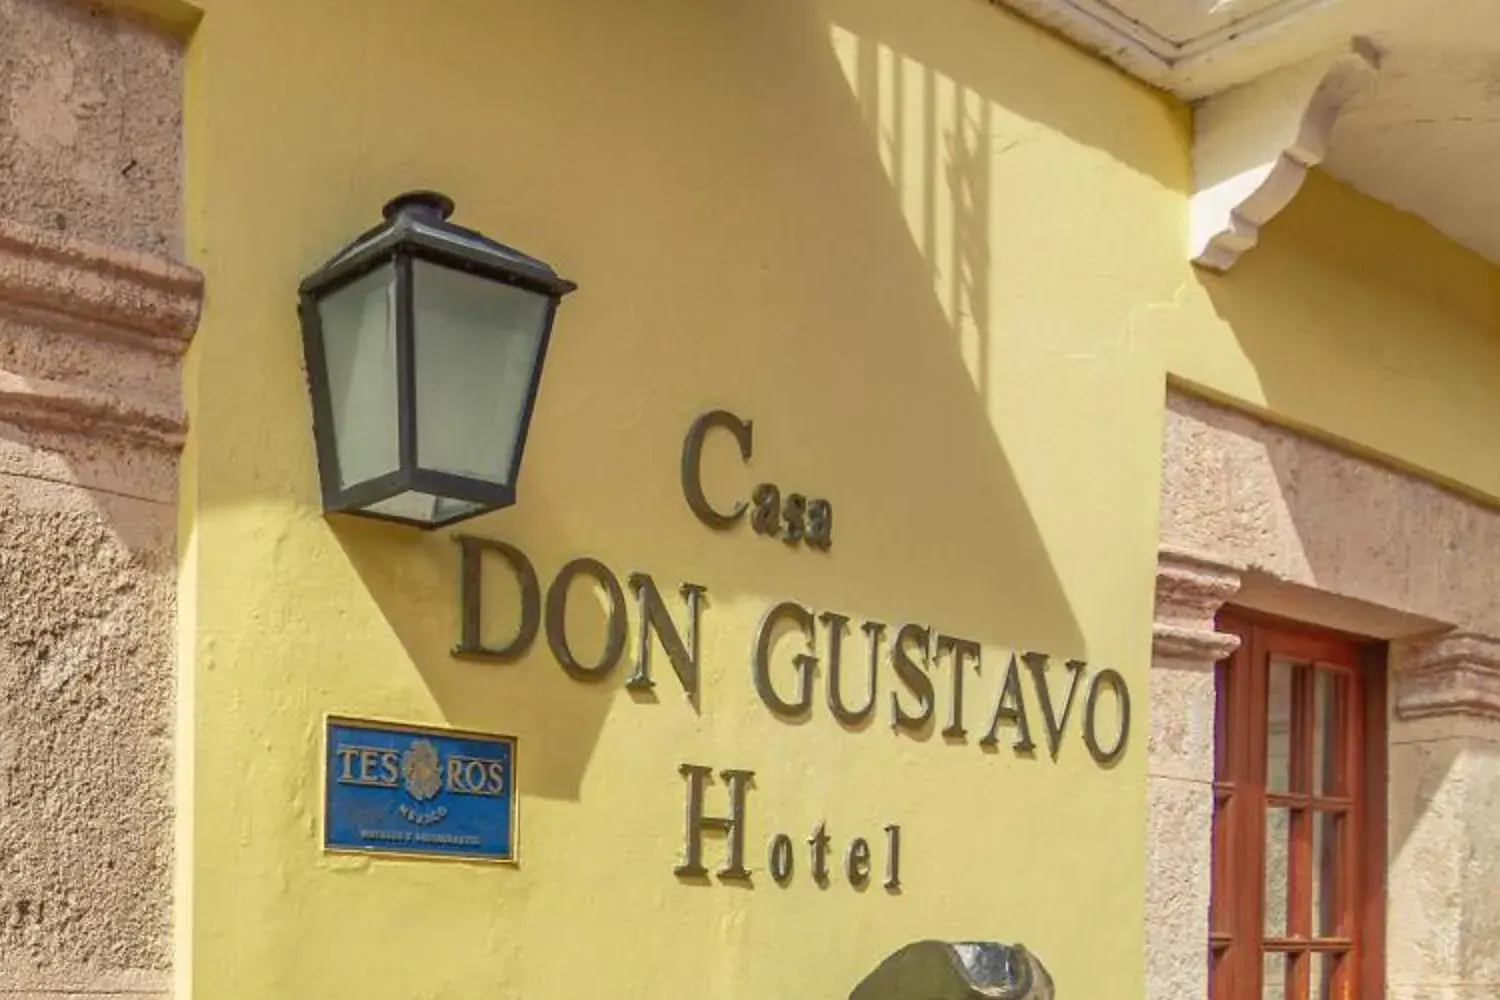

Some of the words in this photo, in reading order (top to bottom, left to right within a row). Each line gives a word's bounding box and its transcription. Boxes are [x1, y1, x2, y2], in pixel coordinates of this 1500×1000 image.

[680, 408, 833, 551] Casa
[450, 533, 709, 713] DON
[753, 601, 1132, 769] GUSTAVO
[674, 763, 902, 894] Hotel
